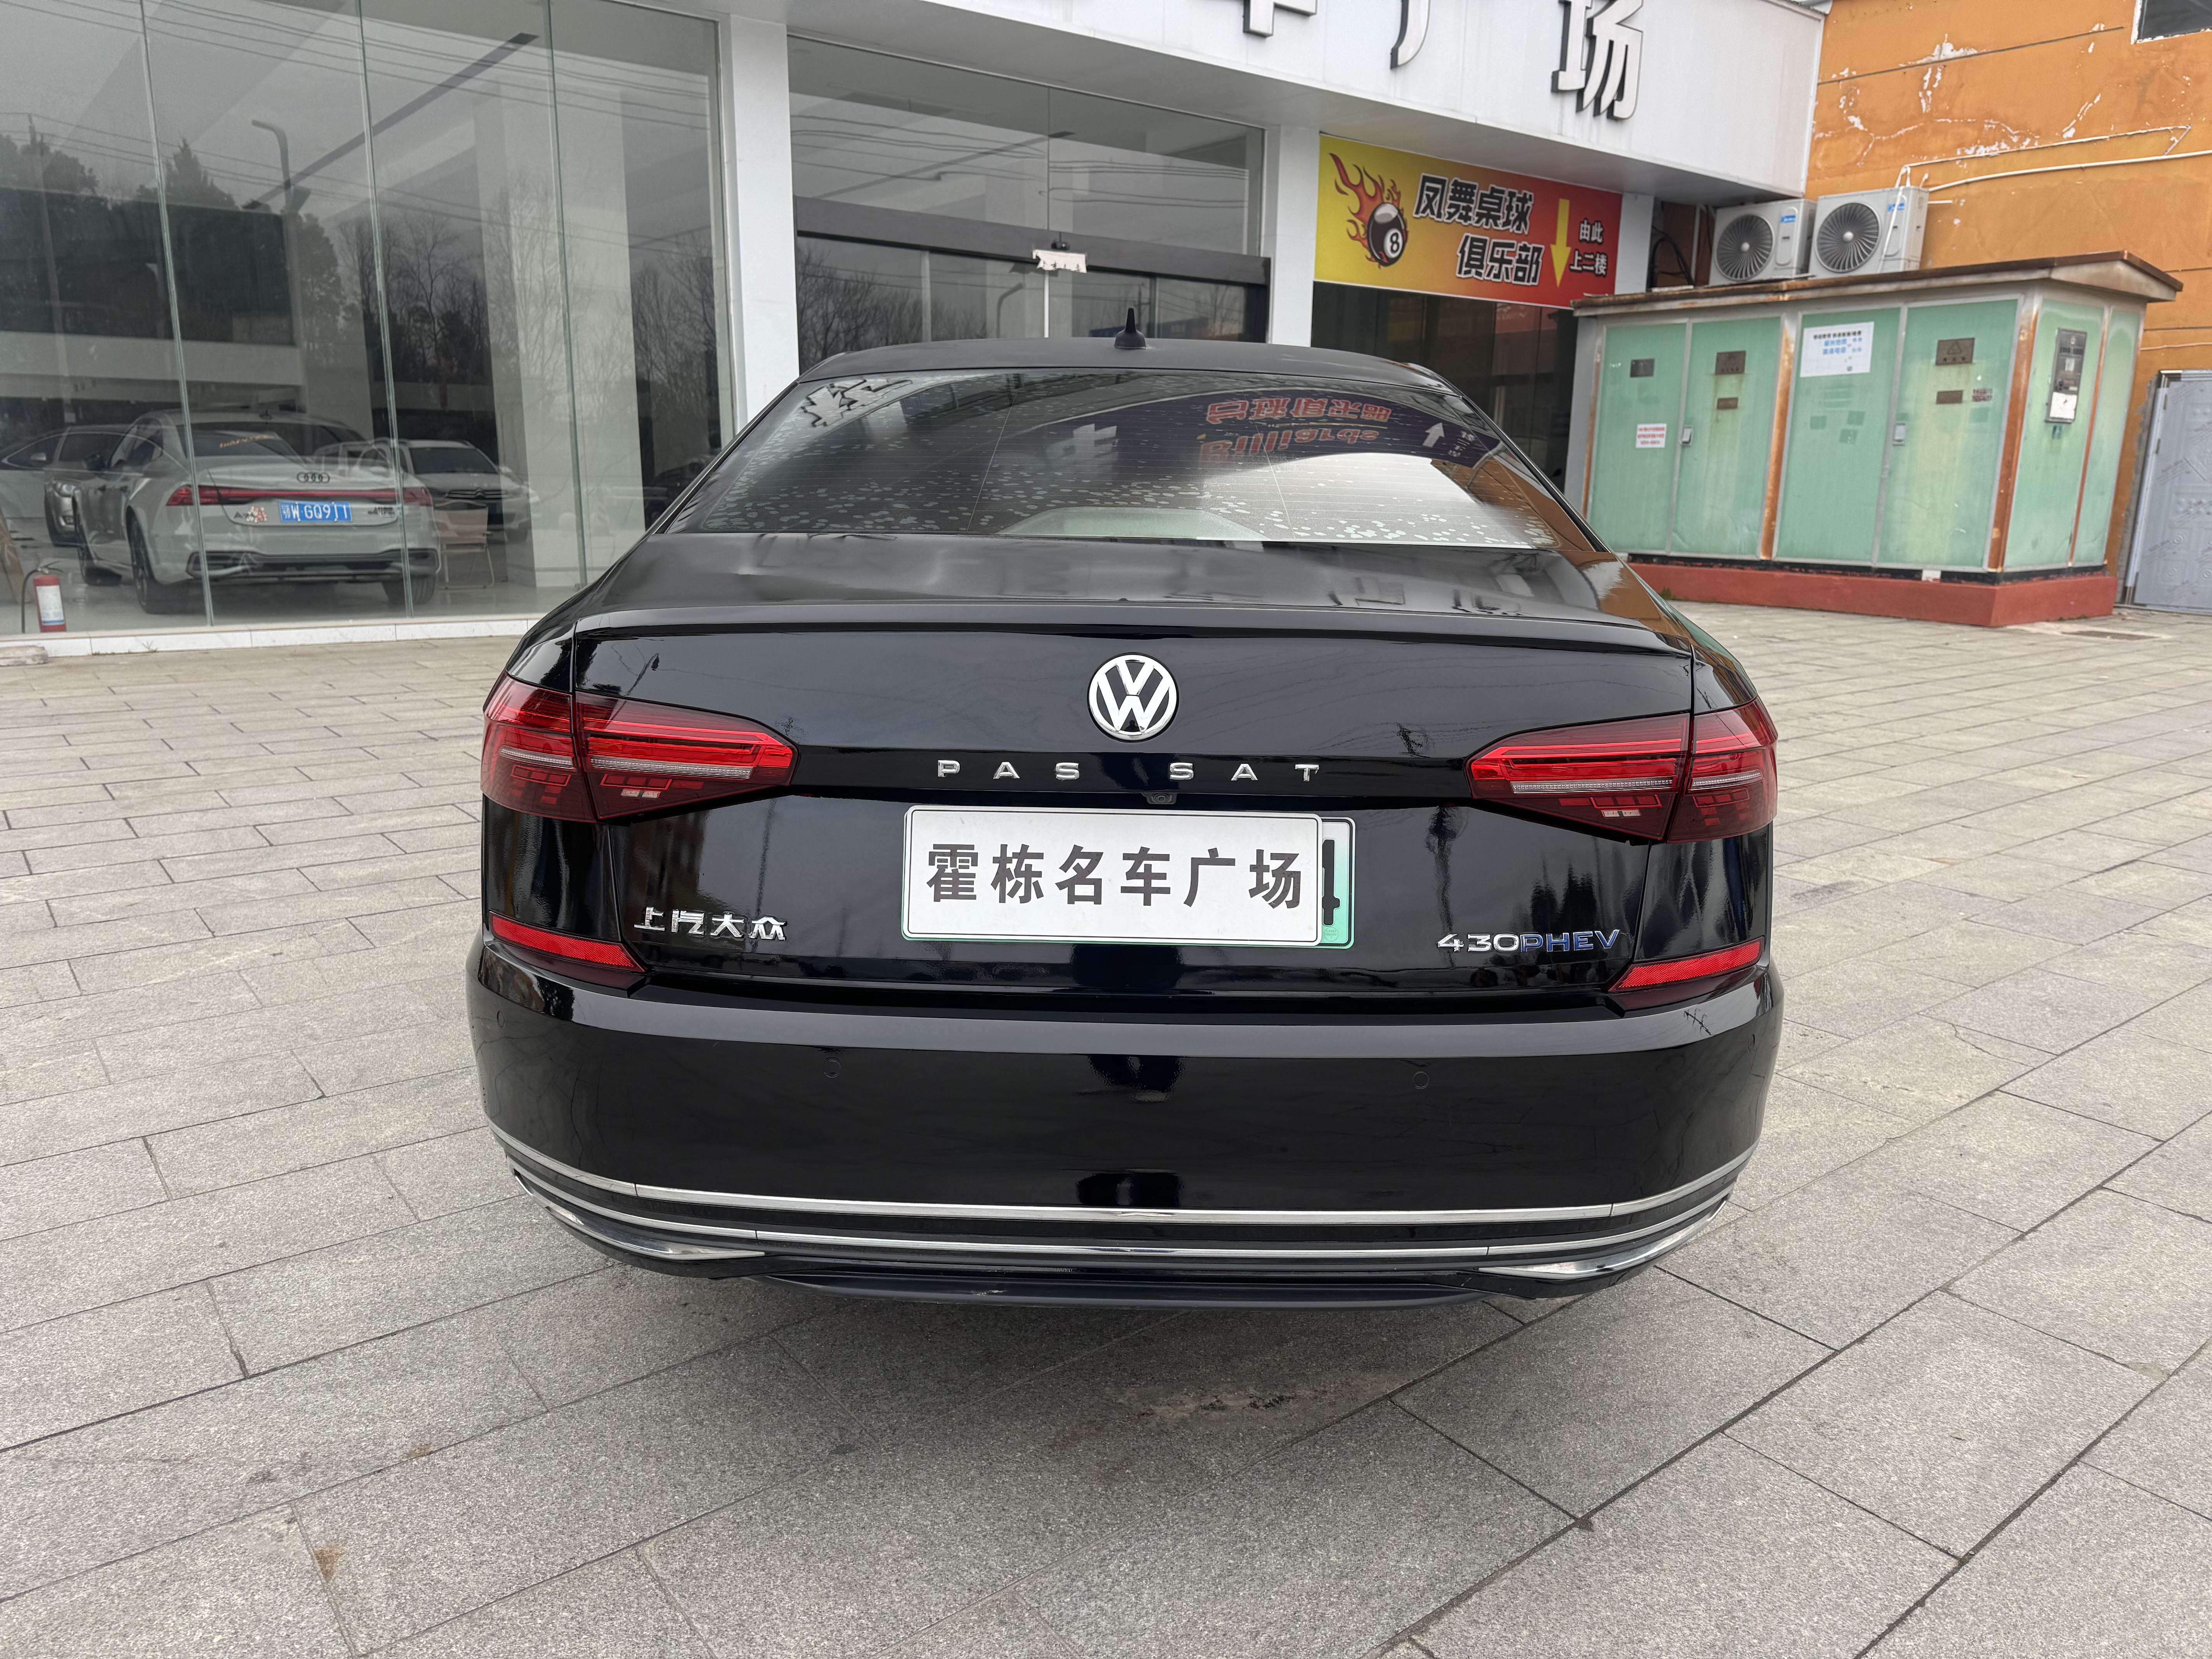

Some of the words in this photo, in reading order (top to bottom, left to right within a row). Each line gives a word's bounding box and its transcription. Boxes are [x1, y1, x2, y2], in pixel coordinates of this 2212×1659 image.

[1413, 173, 1534, 234] 凤舞桌球
[1390, 232, 1400, 253] 8
[1579, 219, 1604, 244] 由此
[1456, 233, 1545, 286] 俱乐部
[1570, 250, 1607, 276] 上二楼
[927, 844, 1302, 908] 霍栋名车广场
[634, 907, 788, 941] 上汽大众
